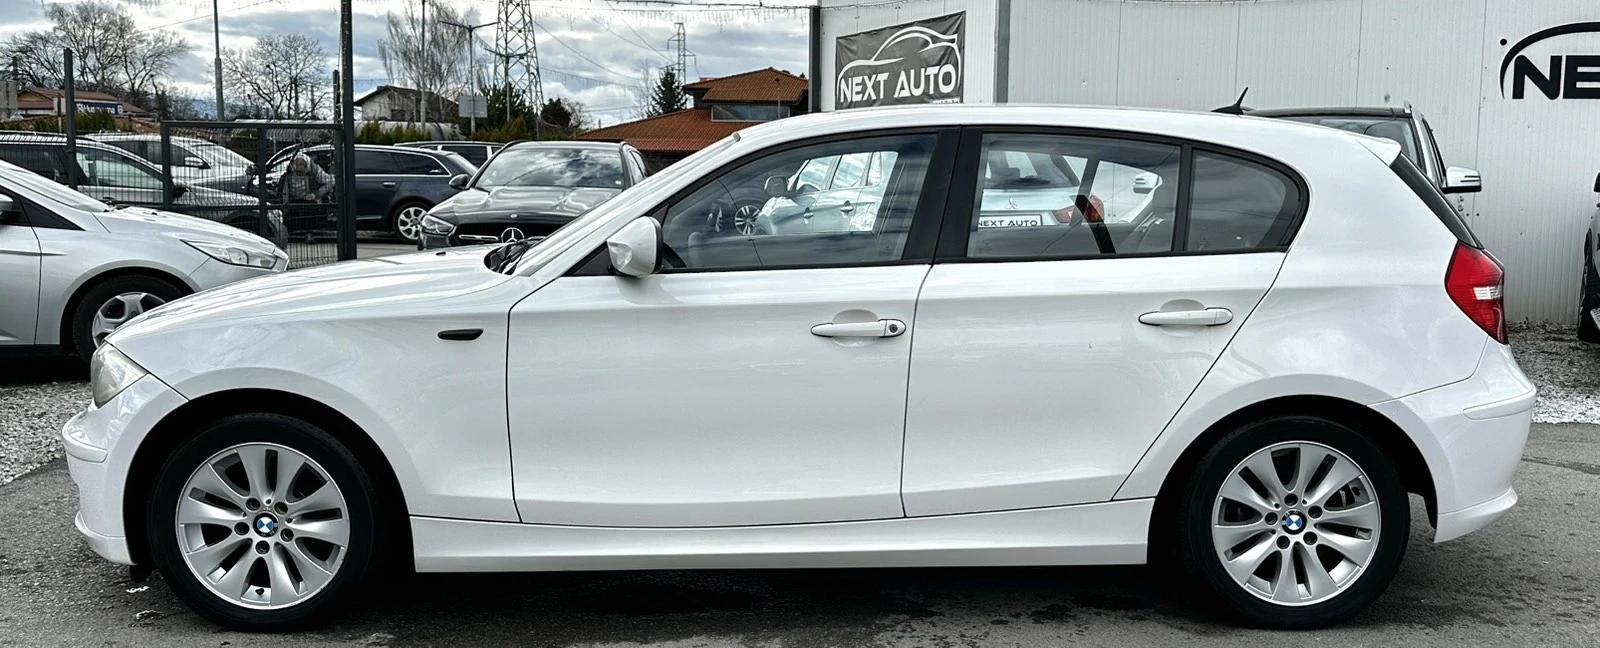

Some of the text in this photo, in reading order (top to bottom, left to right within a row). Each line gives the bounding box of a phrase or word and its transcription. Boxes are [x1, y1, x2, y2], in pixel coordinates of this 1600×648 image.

[840, 63, 956, 103] NEXT AUTO
[1008, 219, 1038, 227] AUTO
